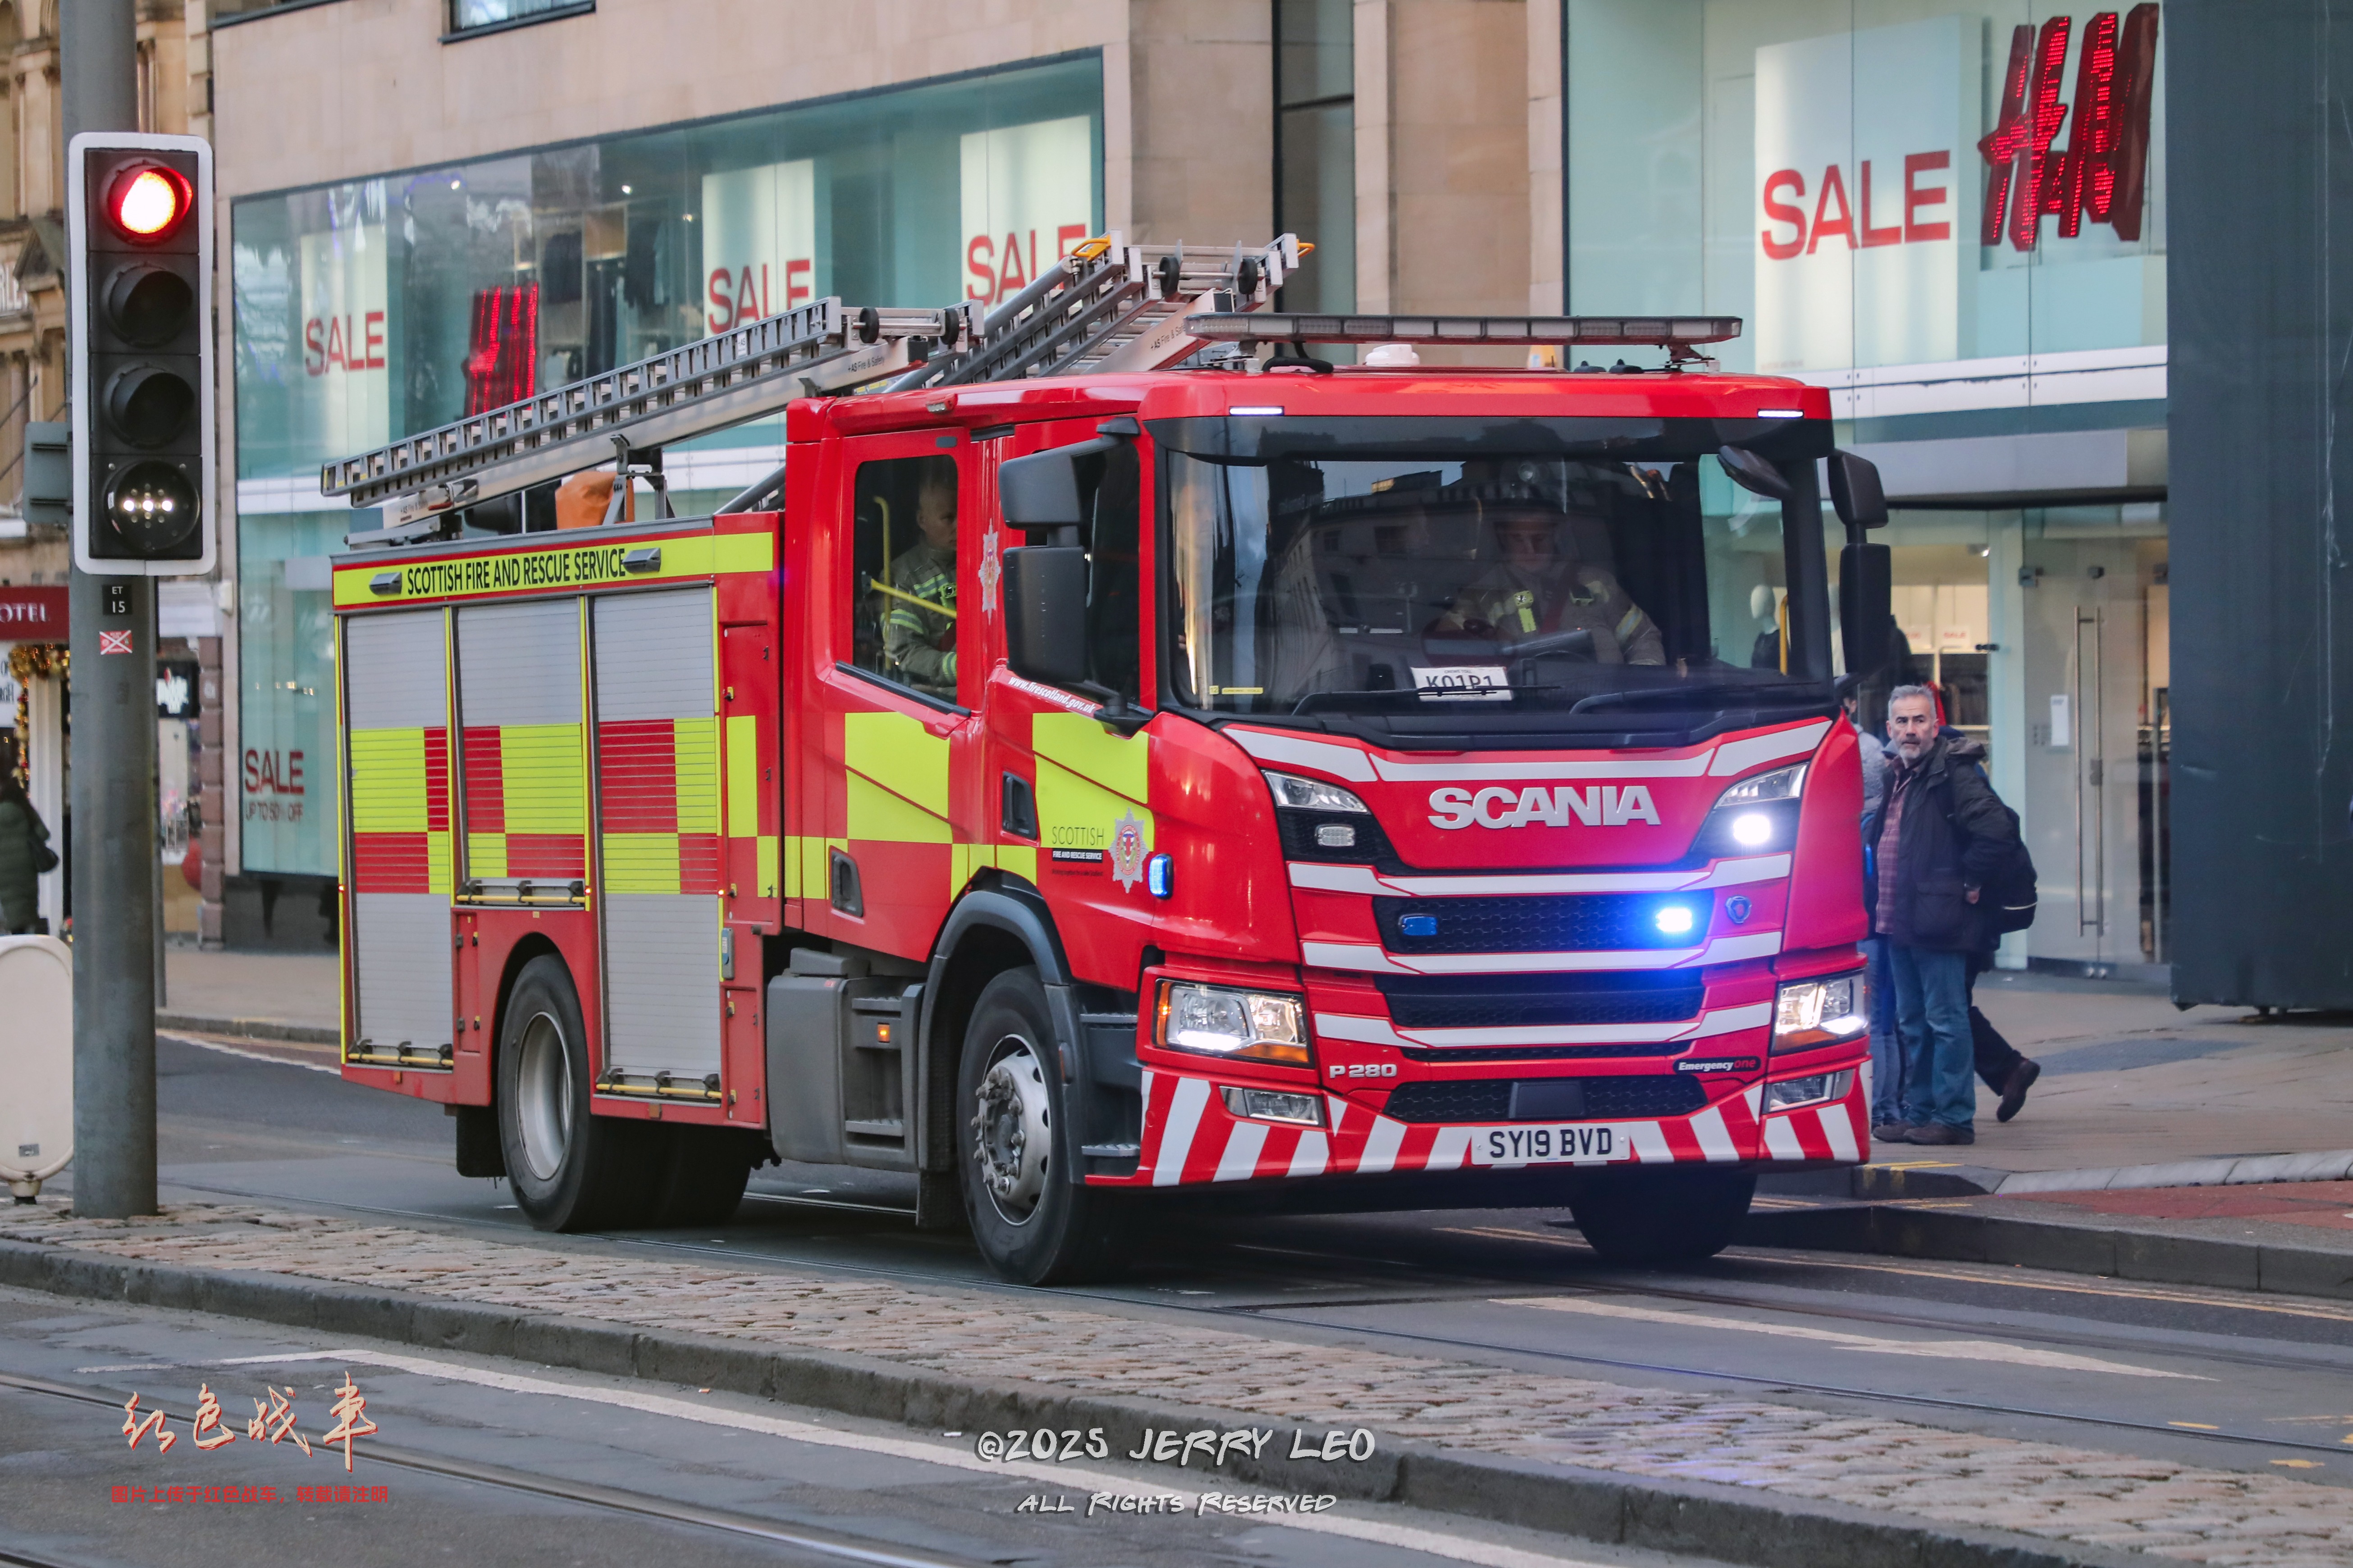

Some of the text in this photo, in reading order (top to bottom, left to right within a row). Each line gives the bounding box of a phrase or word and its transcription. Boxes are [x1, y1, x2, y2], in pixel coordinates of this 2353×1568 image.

[1978, 2, 2160, 251] H&M
[1761, 150, 1950, 260] SALE
[306, 311, 384, 376] SALE
[407, 548, 626, 595] SCOTTISH FIRE AND RESCUE SERVICE
[112, 586, 123, 594] ET
[112, 601, 126, 613] 15
[0, 602, 50, 623] OTEL
[1008, 676, 1096, 714] www.firescotland.gov.uk
[245, 749, 305, 795] SALE
[1428, 785, 1661, 830] SCANIA
[1052, 826, 1104, 846] SCOTTISH
[1085, 852, 1102, 860] SERVICE
[1348, 1063, 1397, 1078] 280
[1489, 1128, 1611, 1158] SY19 BVD
